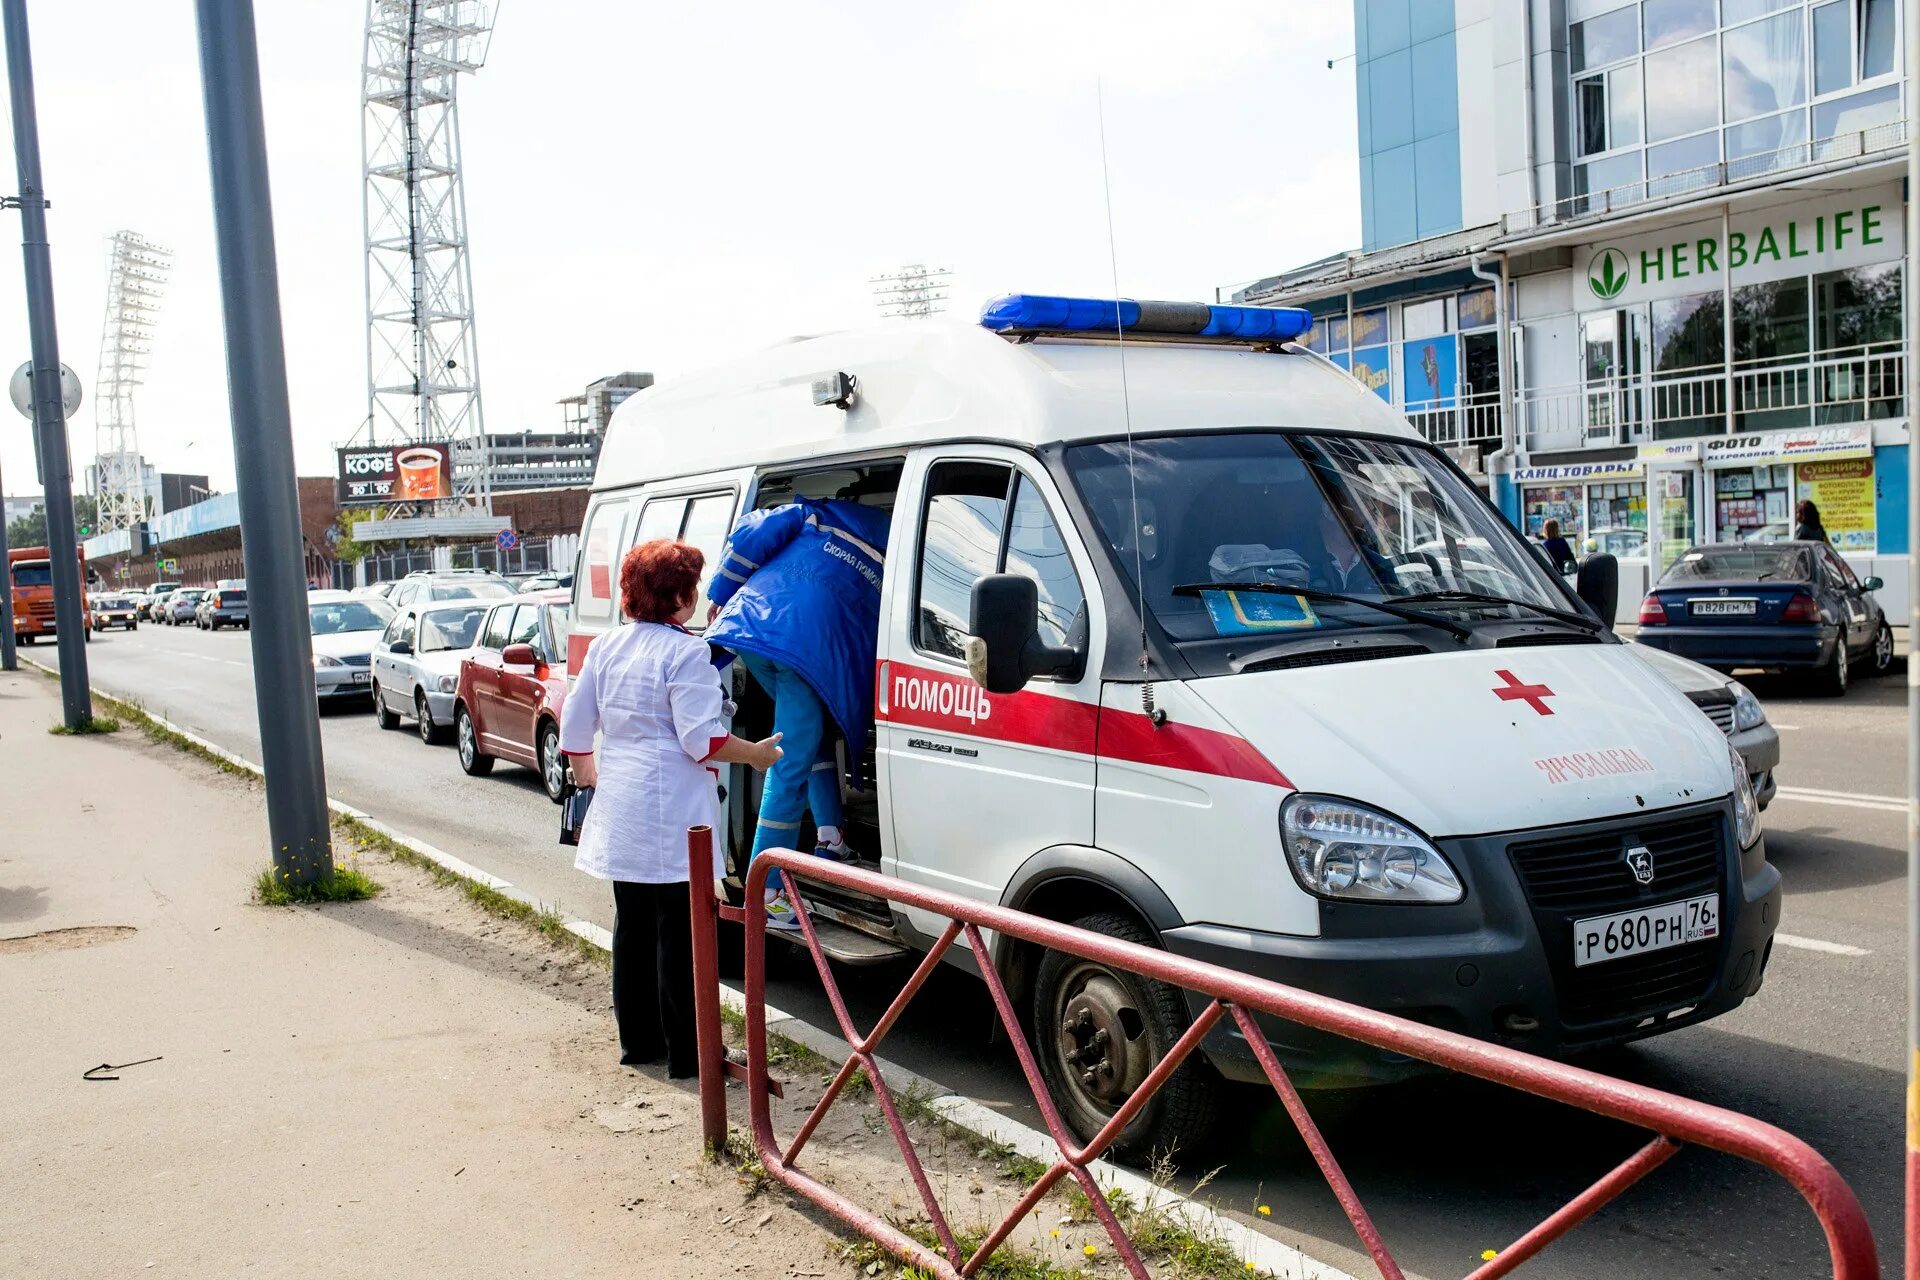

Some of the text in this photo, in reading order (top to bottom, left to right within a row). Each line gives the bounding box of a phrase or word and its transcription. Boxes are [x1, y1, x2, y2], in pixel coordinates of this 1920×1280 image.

[1640, 206, 1883, 284] HERBALIFE
[345, 458, 394, 474] КОФЕ
[1804, 461, 1867, 475] СУВЕНИРЫ
[823, 541, 857, 566] СКОРАЯ
[894, 676, 991, 726] ПОМОЩЬ
[1689, 900, 1711, 928] 76
[1687, 928, 1704, 940] RUS
